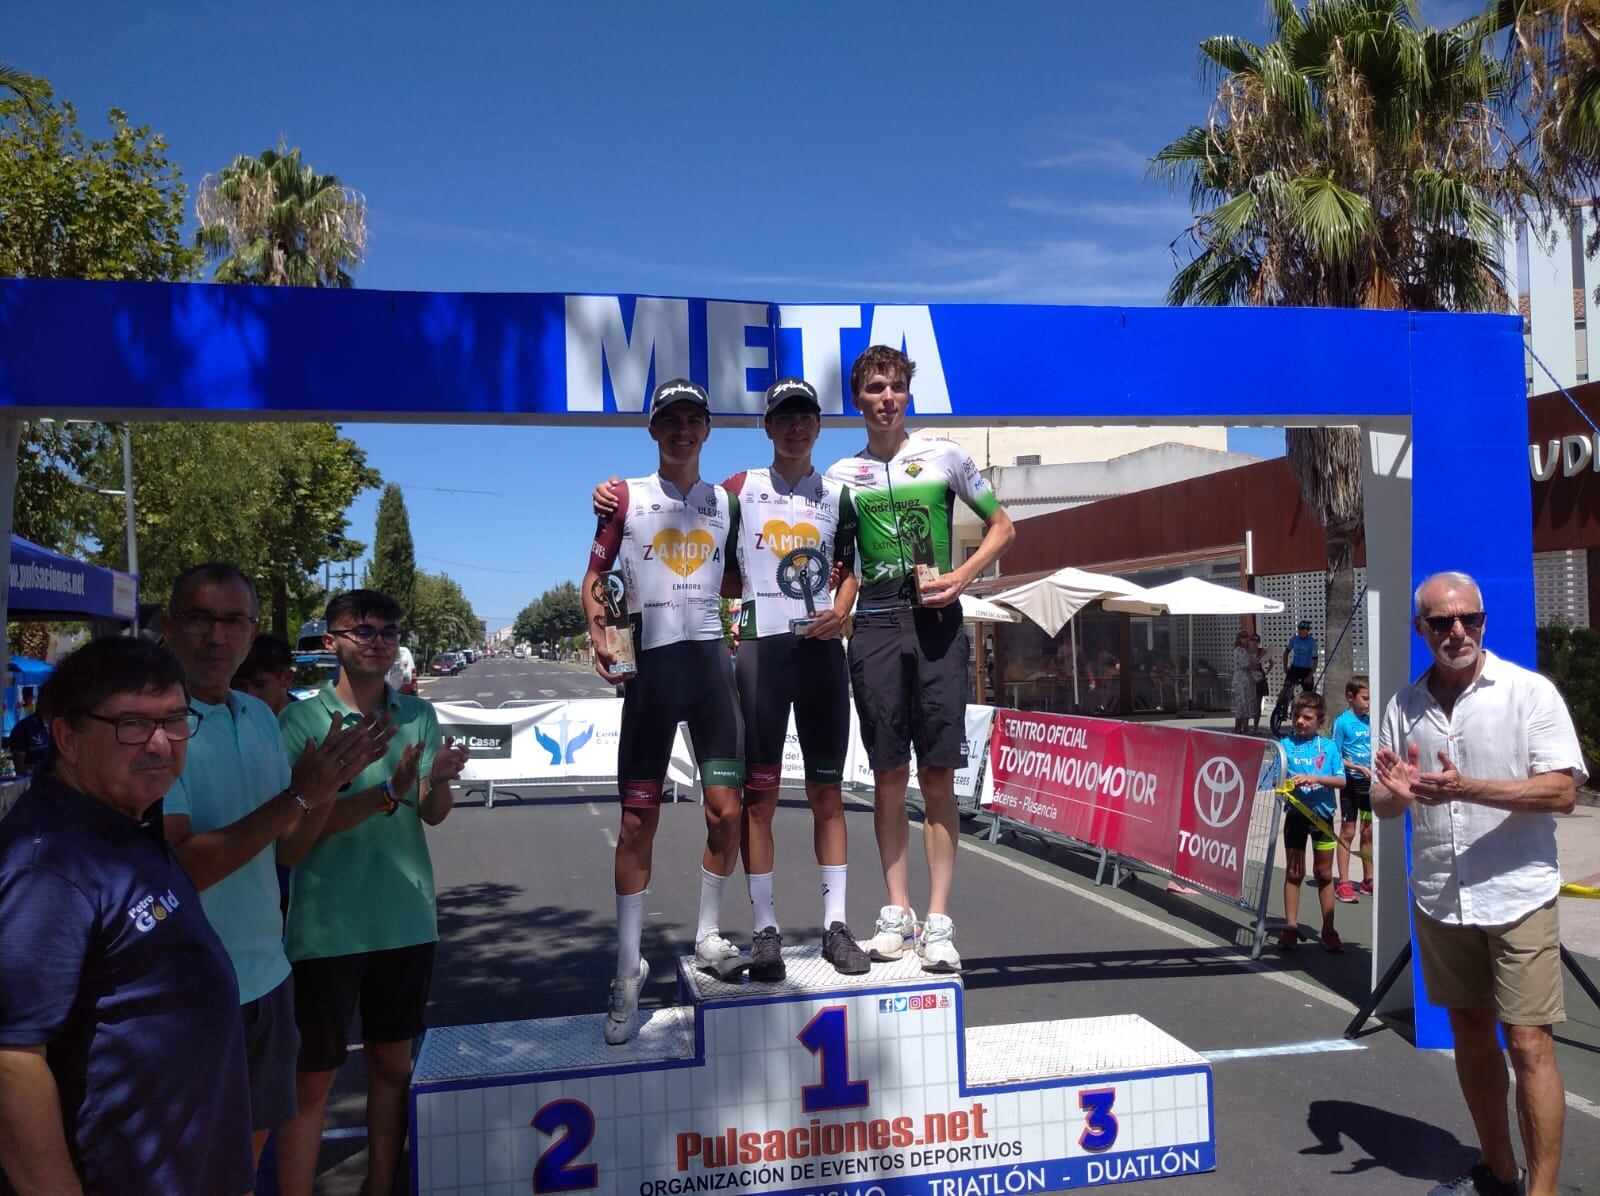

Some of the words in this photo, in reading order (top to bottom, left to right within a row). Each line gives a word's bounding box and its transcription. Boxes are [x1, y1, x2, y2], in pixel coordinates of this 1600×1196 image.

[565, 295, 953, 415] META
[1528, 432, 1600, 481] UDI
[9, 560, 85, 595] w.pulsaciones.net
[642, 543, 720, 563] ZAMORA
[469, 736, 501, 747] Casar
[1005, 719, 1046, 743] CENTRO
[1047, 724, 1088, 749] OFICIAL
[999, 746, 1052, 779] TOYOTA
[1052, 755, 1158, 806] NOVOMOTOR
[1022, 795, 1057, 819] Plasencia
[1178, 829, 1238, 871] TOYOTA
[128, 895, 154, 919] Petro
[797, 1005, 869, 1113] 1
[676, 1102, 989, 1172] Pulsaciones.net
[1078, 1086, 1119, 1154] 3
[530, 1098, 598, 1195] 2
[640, 1164, 785, 1196] ORGANIZACIÓN
[791, 1163, 815, 1181] DE
[821, 1154, 905, 1178] EVENTOS
[911, 1140, 1023, 1167] DEPORTIVOS
[929, 1164, 1046, 1196] TRIATLÓN
[1087, 1146, 1199, 1184] DUATLÓN
